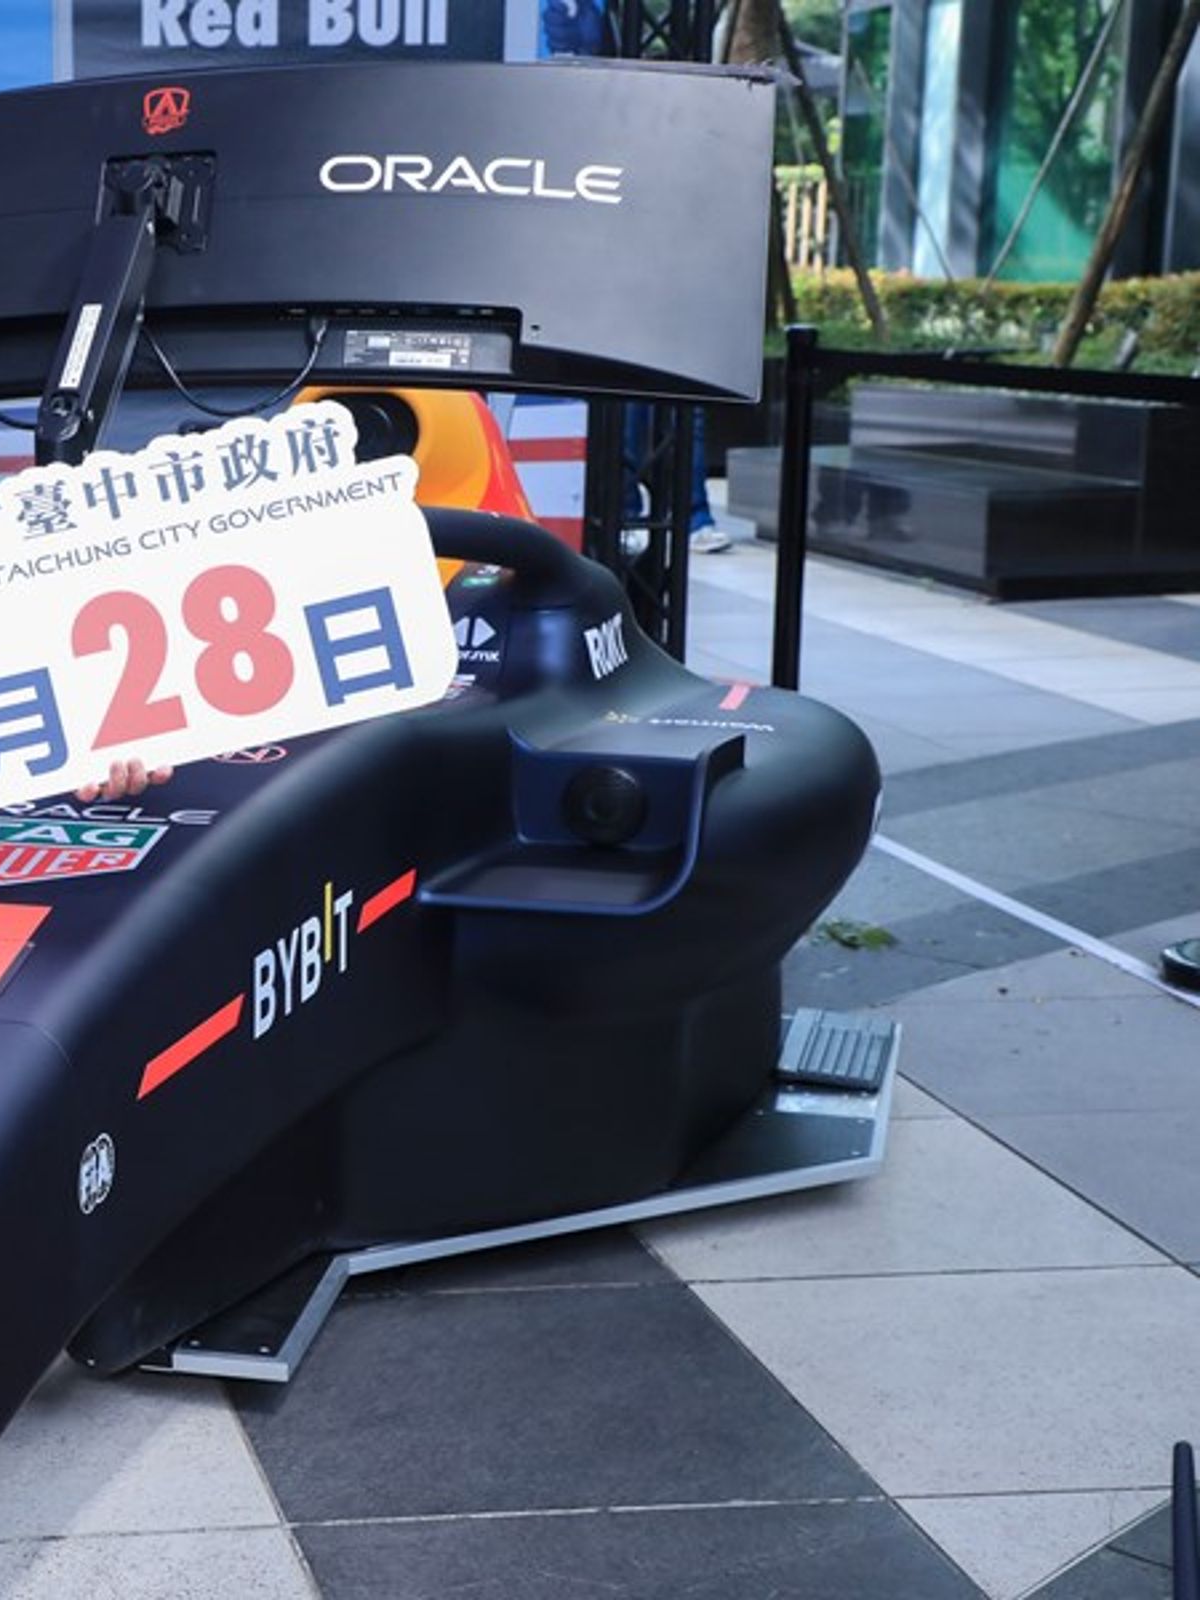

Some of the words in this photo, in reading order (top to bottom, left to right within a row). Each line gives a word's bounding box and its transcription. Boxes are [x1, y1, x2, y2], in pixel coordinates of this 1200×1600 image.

[141, 0, 278, 47] Red
[308, 0, 448, 46] Bull
[318, 154, 625, 205] ORACLE
[14, 416, 342, 541] 臺中市政府
[138, 518, 202, 551] CITY
[208, 471, 405, 535] GOVERNMENT
[253, 881, 354, 1040] BYBIT
